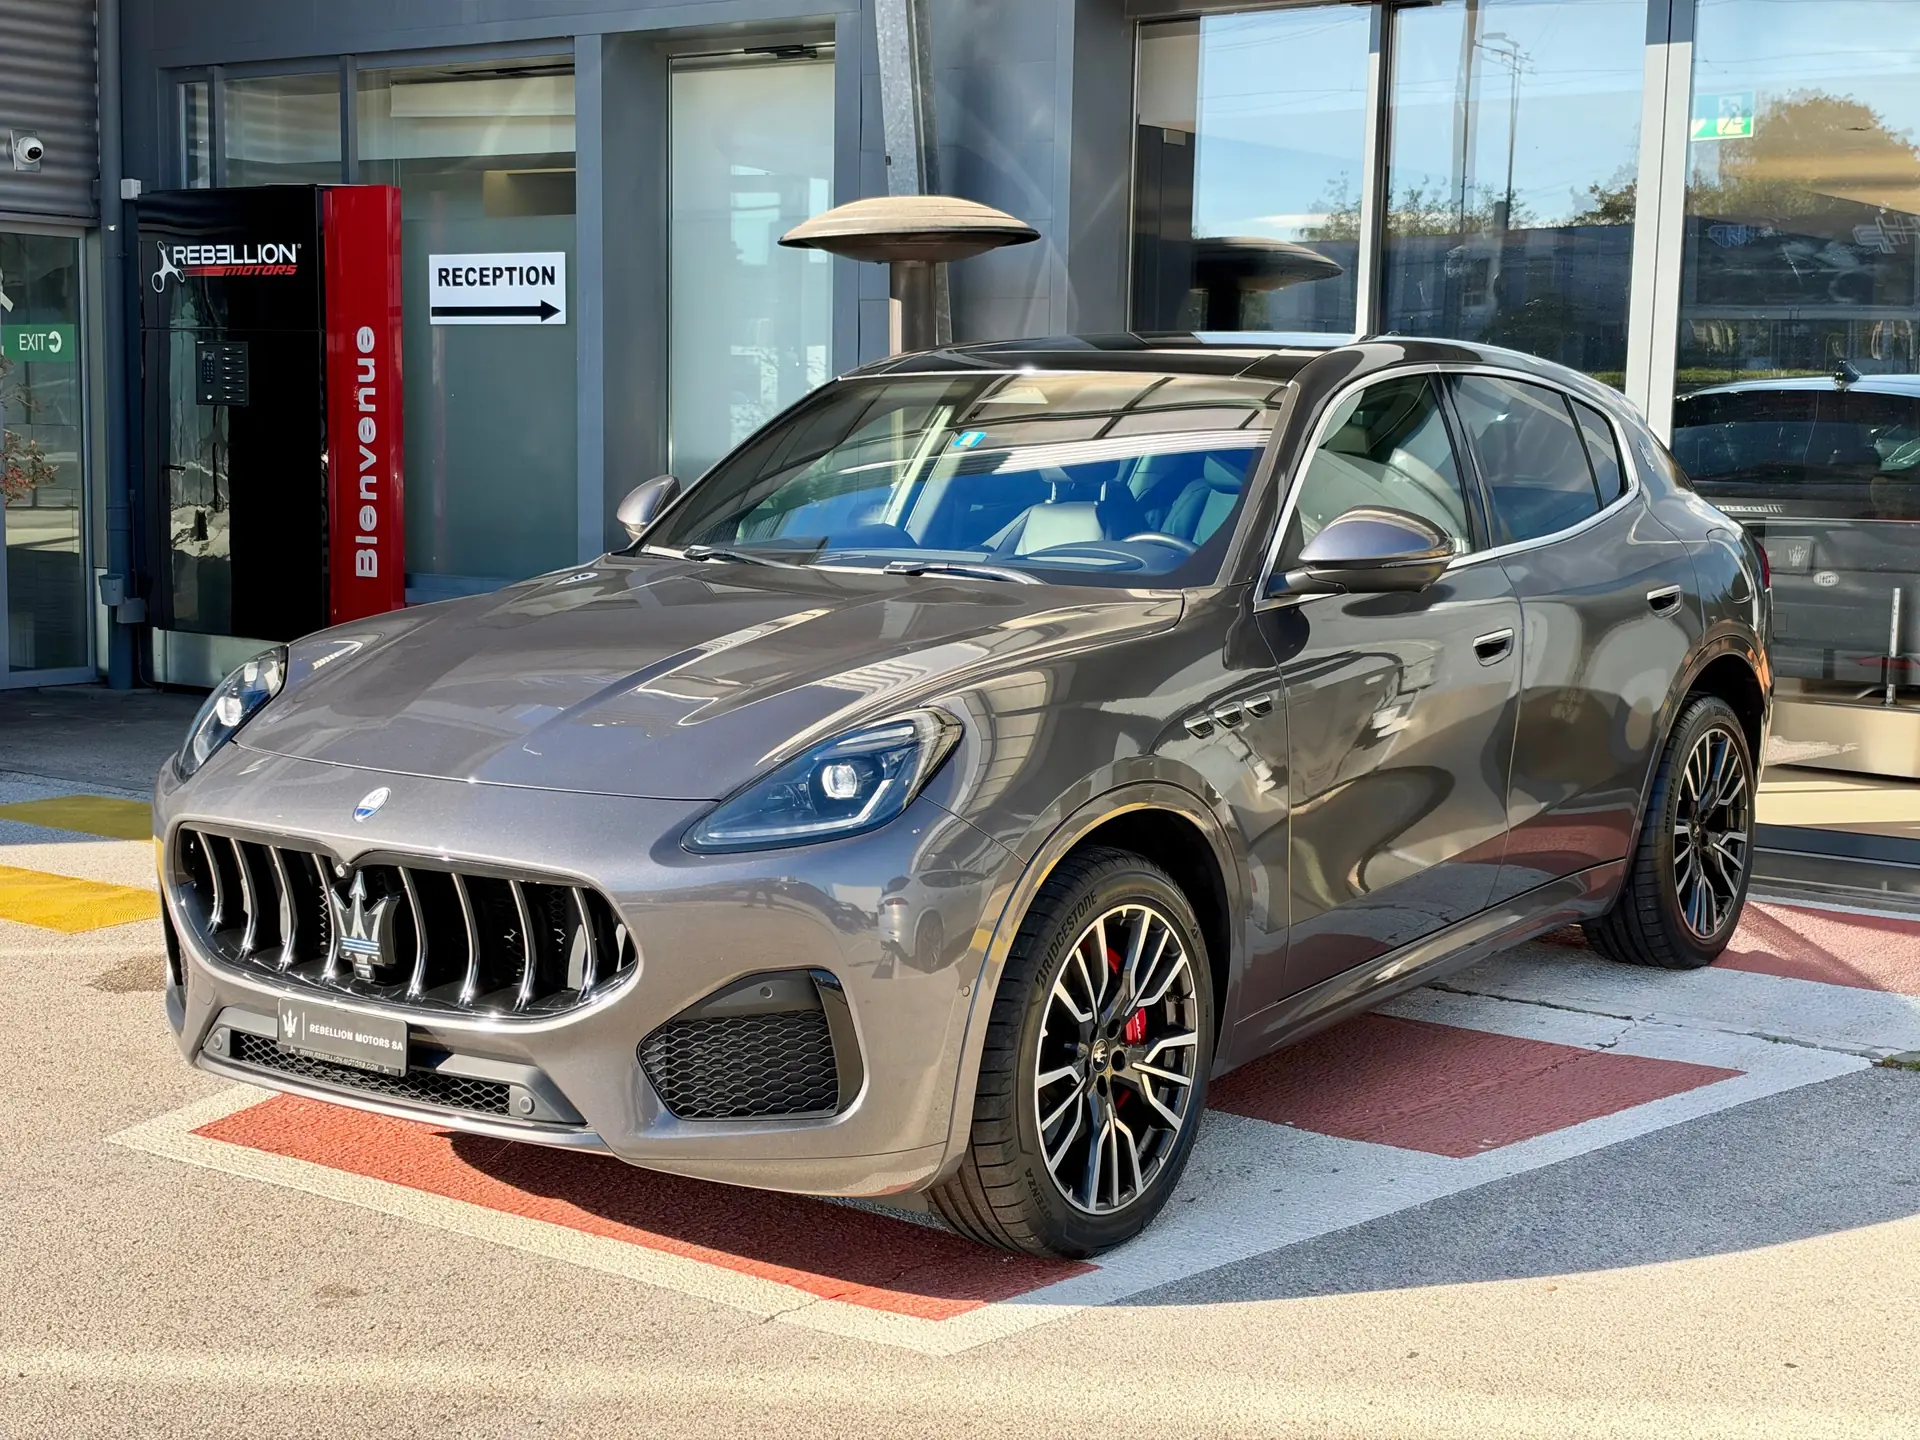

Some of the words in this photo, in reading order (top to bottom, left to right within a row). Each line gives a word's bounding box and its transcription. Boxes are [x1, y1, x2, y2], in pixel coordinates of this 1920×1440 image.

[173, 243, 297, 265] REBELLION
[438, 266, 555, 287] RECEPTION
[19, 333, 47, 351] EXIT
[355, 326, 378, 578] Bienvenue
[1035, 888, 1098, 991] BRIDGESTONE
[309, 1023, 353, 1041] REBELLION
[355, 1032, 390, 1049] MOTORS
[391, 1041, 404, 1051] SA
